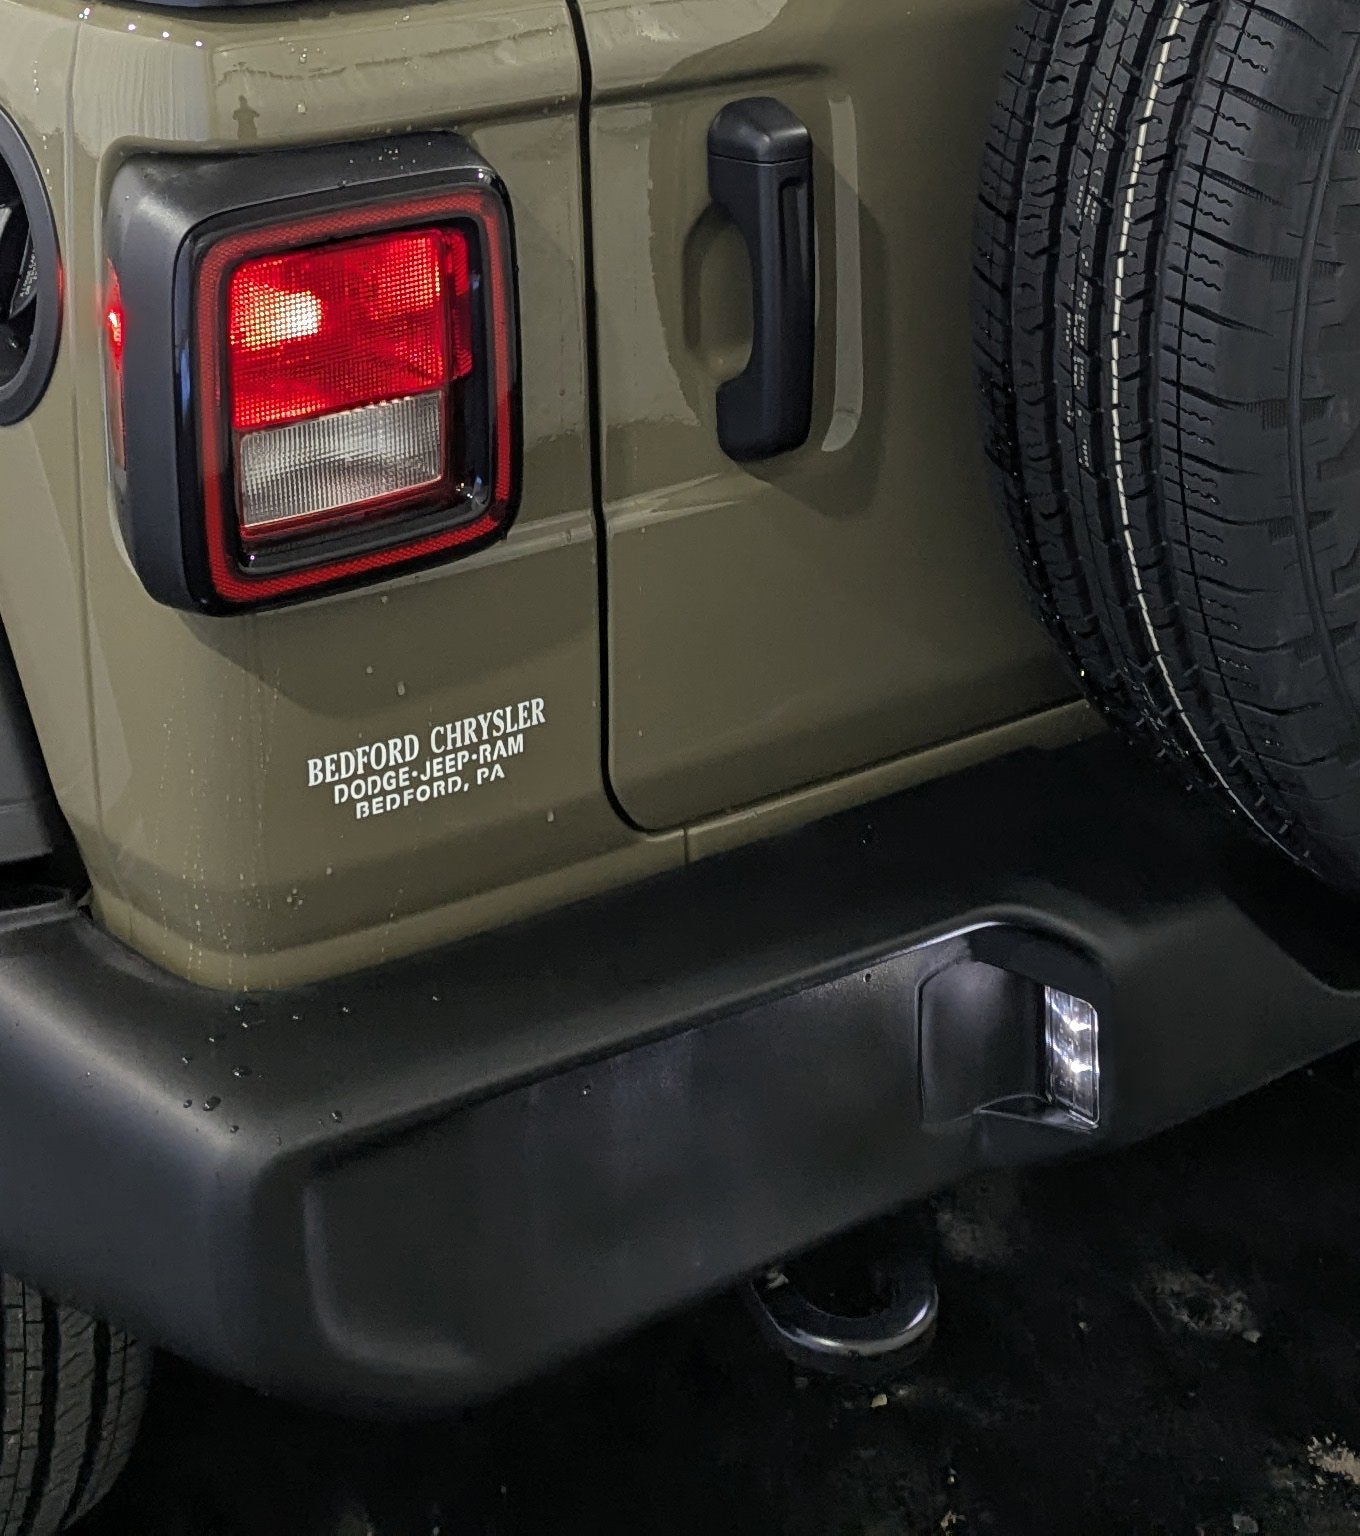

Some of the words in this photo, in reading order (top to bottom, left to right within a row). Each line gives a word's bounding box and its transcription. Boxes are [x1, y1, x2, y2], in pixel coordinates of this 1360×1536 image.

[307, 734, 420, 787] BEDFORD
[430, 697, 546, 753] CHRYSLER
[355, 775, 470, 820] BEDFORD,
[476, 763, 506, 786] PA
